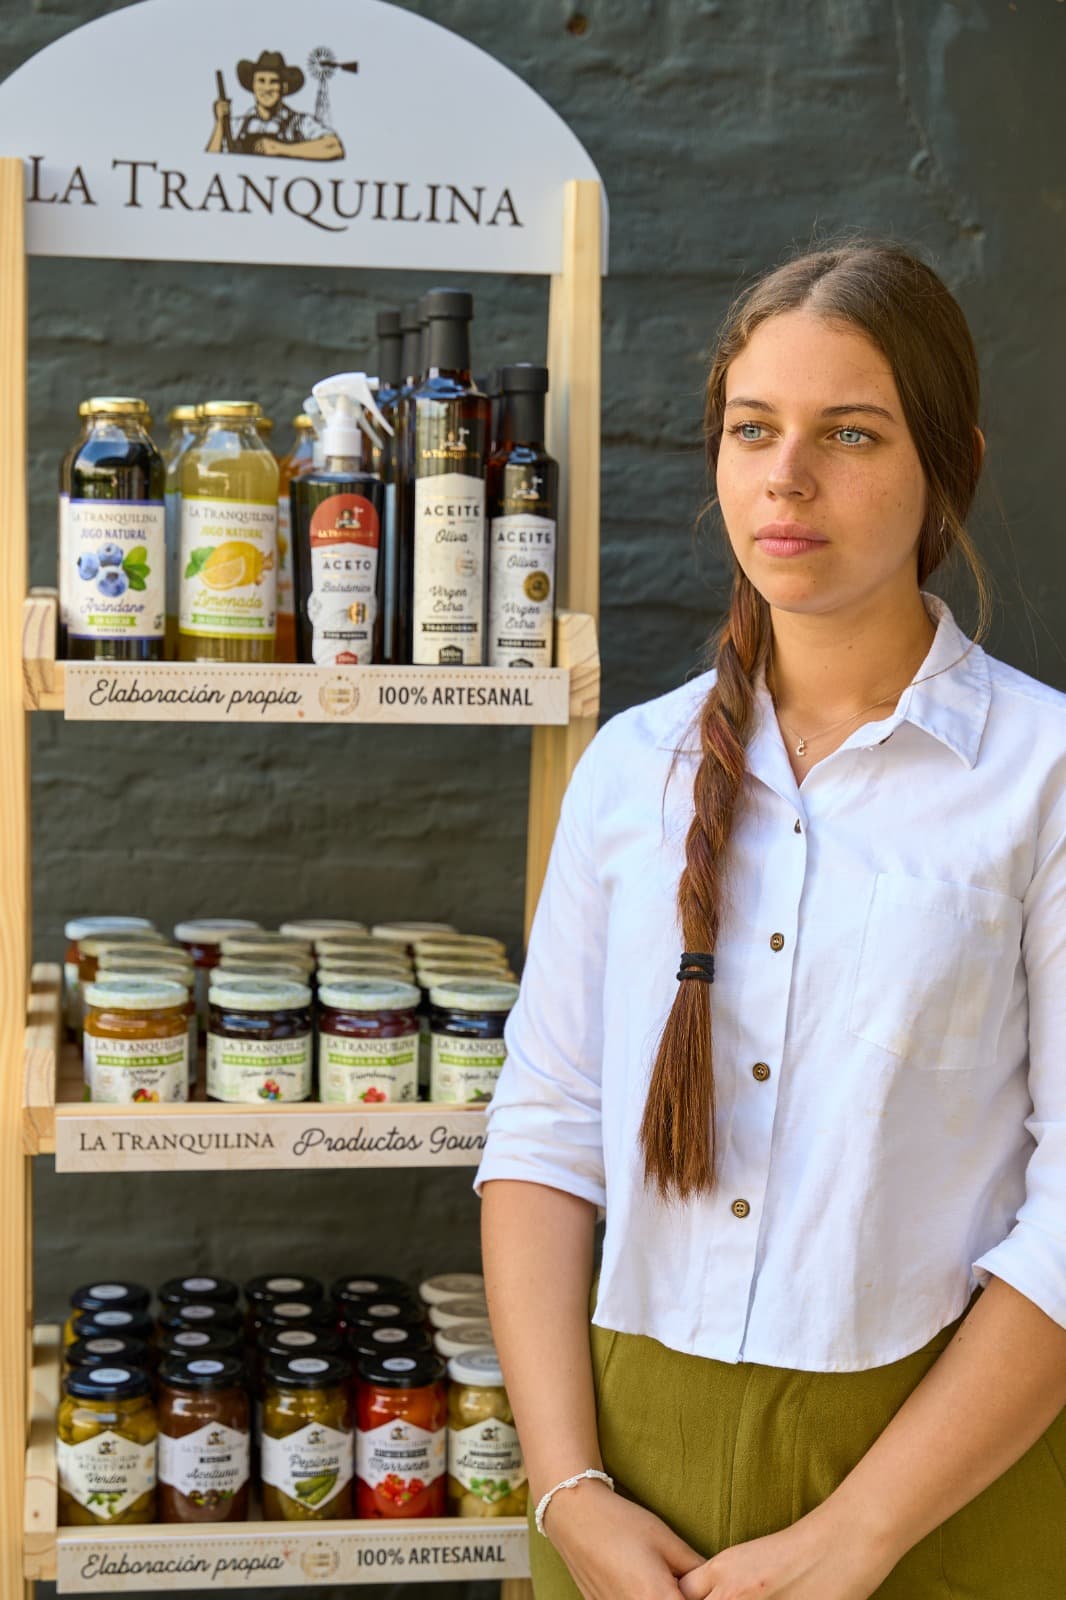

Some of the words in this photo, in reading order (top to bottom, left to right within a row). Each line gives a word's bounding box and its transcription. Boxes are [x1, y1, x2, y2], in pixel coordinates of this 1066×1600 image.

[26, 155, 97, 206] LA
[112, 158, 525, 233] TRANQUILINA
[84, 511, 158, 526] TRANQUILINA
[203, 507, 275, 525] TRANQUILINA
[424, 504, 481, 518] ACEITE
[105, 528, 148, 541] NATURAL
[436, 528, 468, 544] Oliva
[497, 531, 552, 544] ACEITE
[322, 560, 373, 571] ACETO
[507, 554, 539, 569] Oliva
[428, 585, 468, 600] Virgen
[432, 601, 464, 612] Extra
[89, 678, 225, 706] Elaboración
[226, 686, 302, 714] propia
[378, 686, 428, 705] 100%
[432, 686, 534, 706] ARTESANAL
[80, 1133, 106, 1151] LA
[112, 1132, 275, 1155] TRANQUILINA
[293, 1126, 424, 1156] Productos
[357, 1549, 404, 1566] 100%
[408, 1545, 506, 1564] ARTESANAL
[81, 1553, 211, 1579] Elaboración
[212, 1554, 285, 1580] propia
